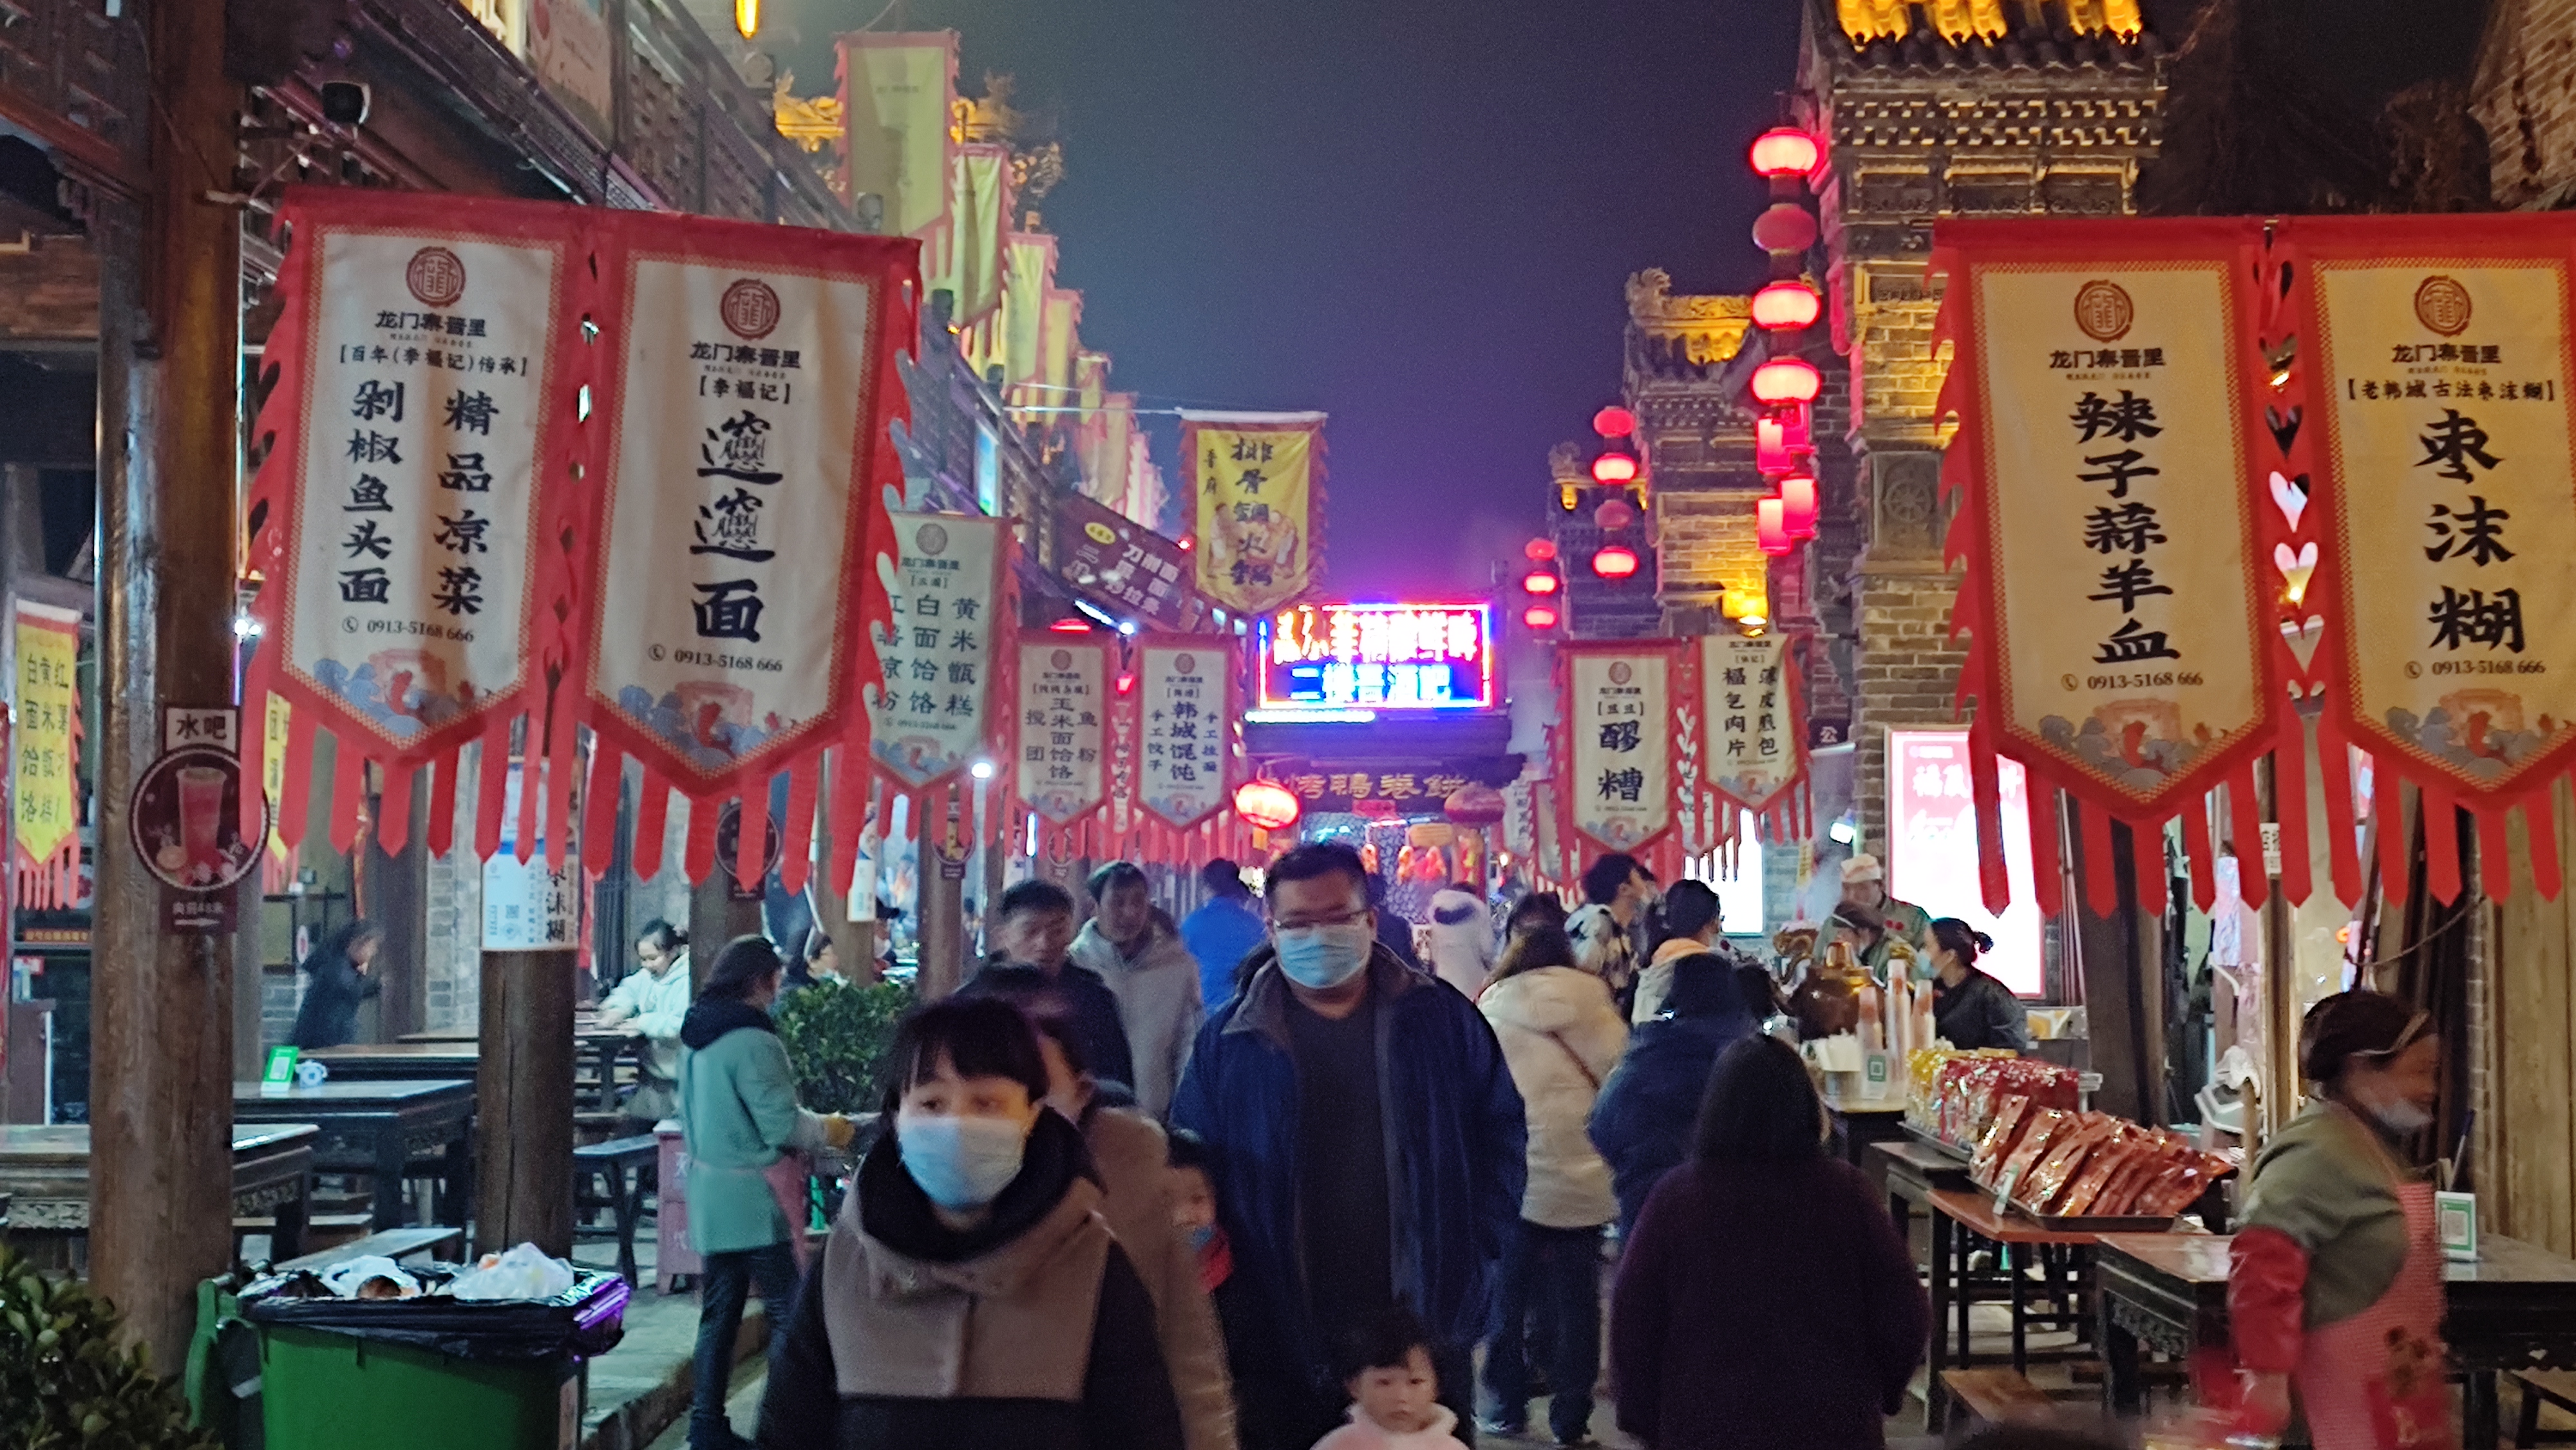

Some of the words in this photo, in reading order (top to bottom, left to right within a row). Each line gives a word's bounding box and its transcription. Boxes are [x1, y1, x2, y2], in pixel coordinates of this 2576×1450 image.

[338, 379, 405, 605] 剁椒鱼头面
[431, 389, 500, 616] 精品凉菜
[2069, 389, 2181, 664] 辣子蒜羊血
[2412, 408, 2525, 654] 枣沫糊
[367, 619, 442, 638] 0913-5168
[446, 625, 474, 643] 666
[674, 649, 753, 670] 0913-5168
[756, 657, 783, 673] 666
[909, 594, 941, 714] 白面饸饹
[2432, 661, 2513, 676] 0913-5168
[2516, 661, 2546, 675] 666
[2087, 672, 2174, 690] 0913-5168
[2177, 672, 2203, 686] 666
[176, 714, 227, 740] 水吧
[1170, 701, 1198, 781] 韩城馄饨
[1598, 719, 1643, 802] 醪糟
